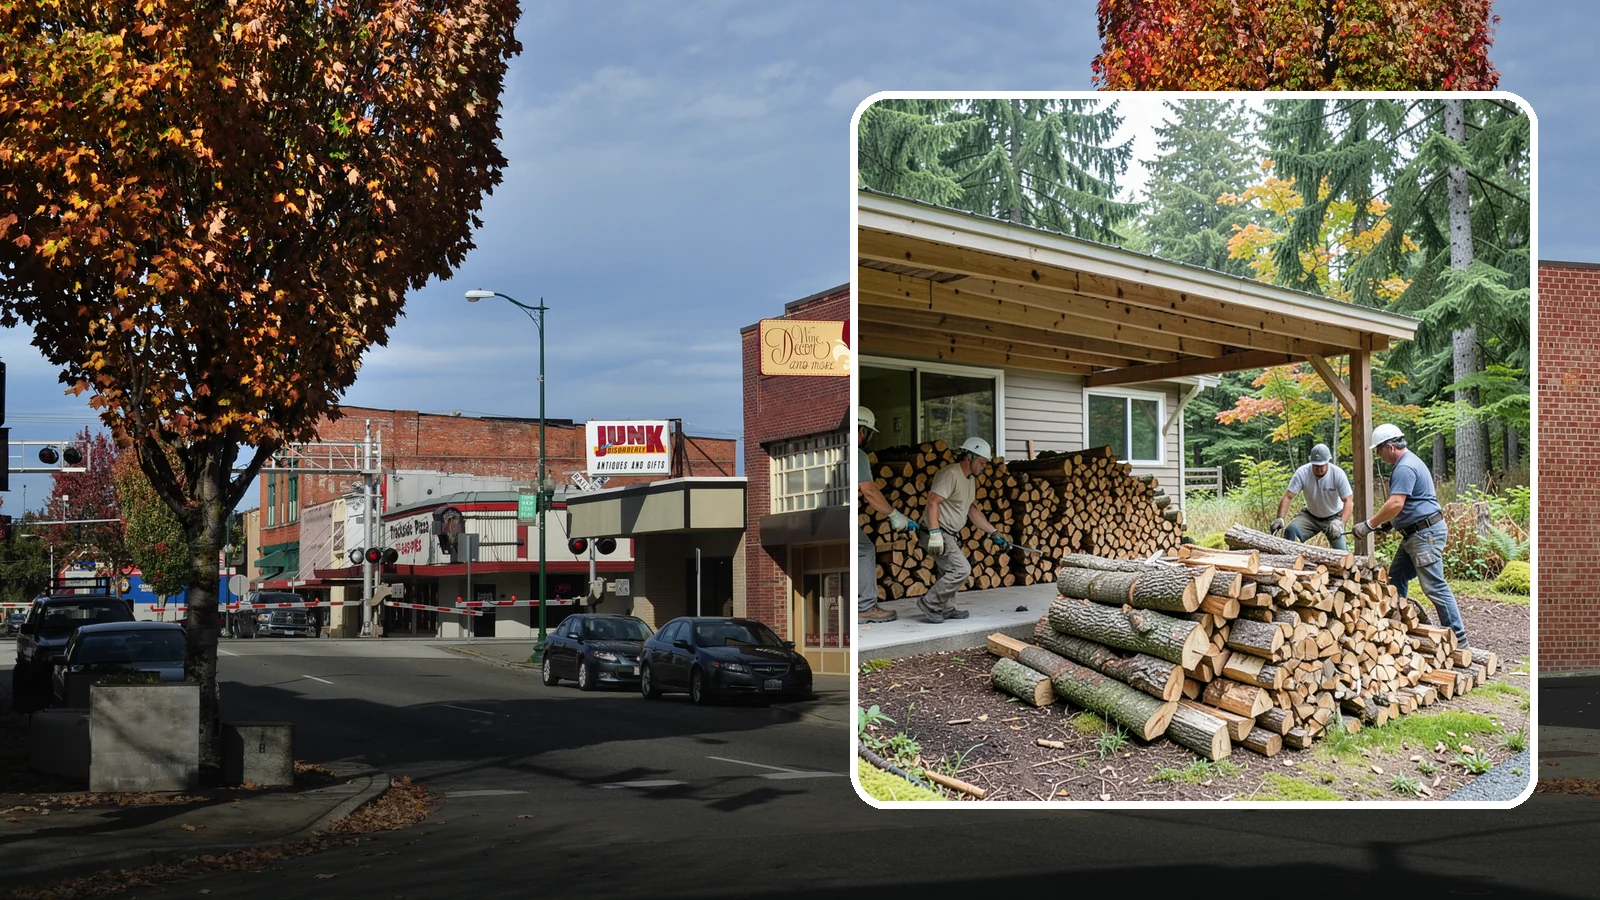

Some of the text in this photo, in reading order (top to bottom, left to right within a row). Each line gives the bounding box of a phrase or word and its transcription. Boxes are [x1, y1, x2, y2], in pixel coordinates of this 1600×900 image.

[596, 425, 665, 457] JUNK
[607, 446, 647, 454] DISORDERLY
[597, 461, 665, 470] ANTIQUES AND GIFTS
[573, 473, 588, 490] RAIL
[414, 519, 429, 534] Pizza
